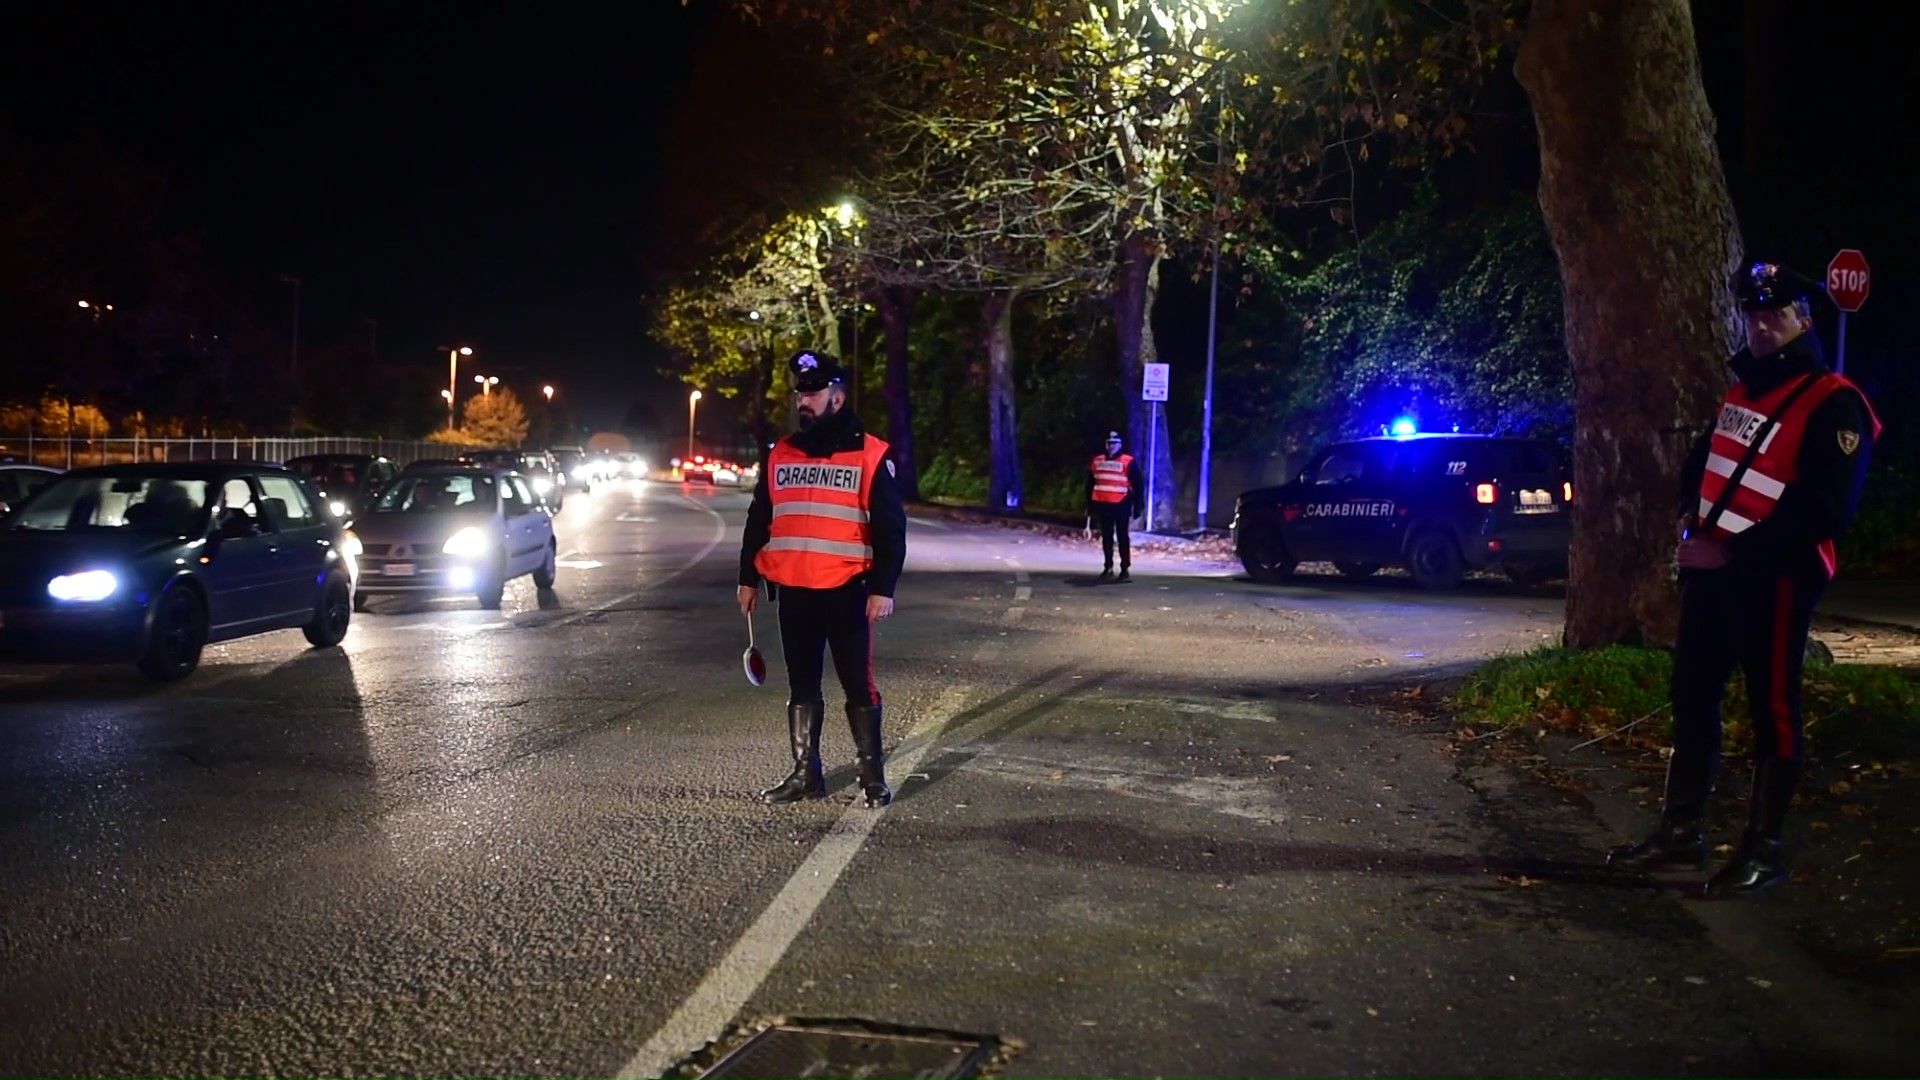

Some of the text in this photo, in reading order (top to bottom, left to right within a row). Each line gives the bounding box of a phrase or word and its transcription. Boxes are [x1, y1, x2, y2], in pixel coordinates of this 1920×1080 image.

[1831, 268, 1867, 293] STOP
[1446, 460, 1468, 474] 112
[776, 467, 858, 490] CARABINIERI
[1306, 503, 1395, 517] CARABINIERI
